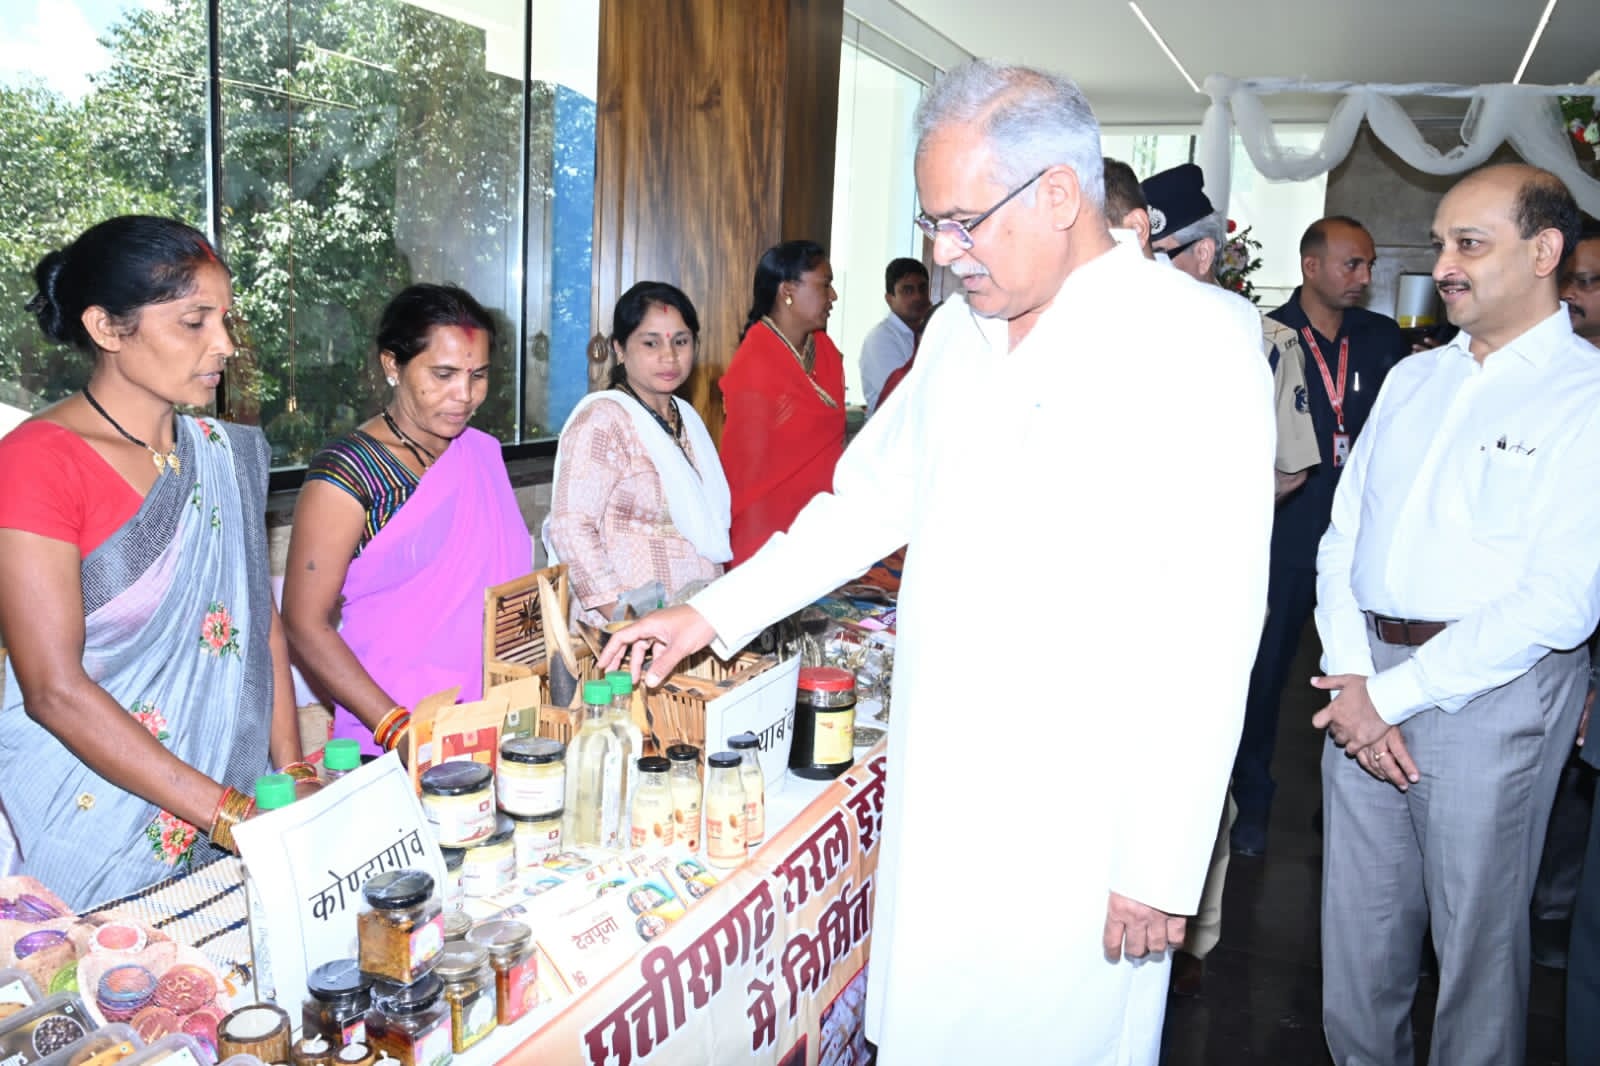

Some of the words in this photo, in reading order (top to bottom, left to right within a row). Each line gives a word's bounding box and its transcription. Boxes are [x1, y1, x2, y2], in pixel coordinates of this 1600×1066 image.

[571, 916, 620, 950] देवपूजा
[584, 879, 776, 1066] छत्तीसगढ़
[748, 957, 776, 1051] में
[781, 880, 872, 1020] निर्मित
